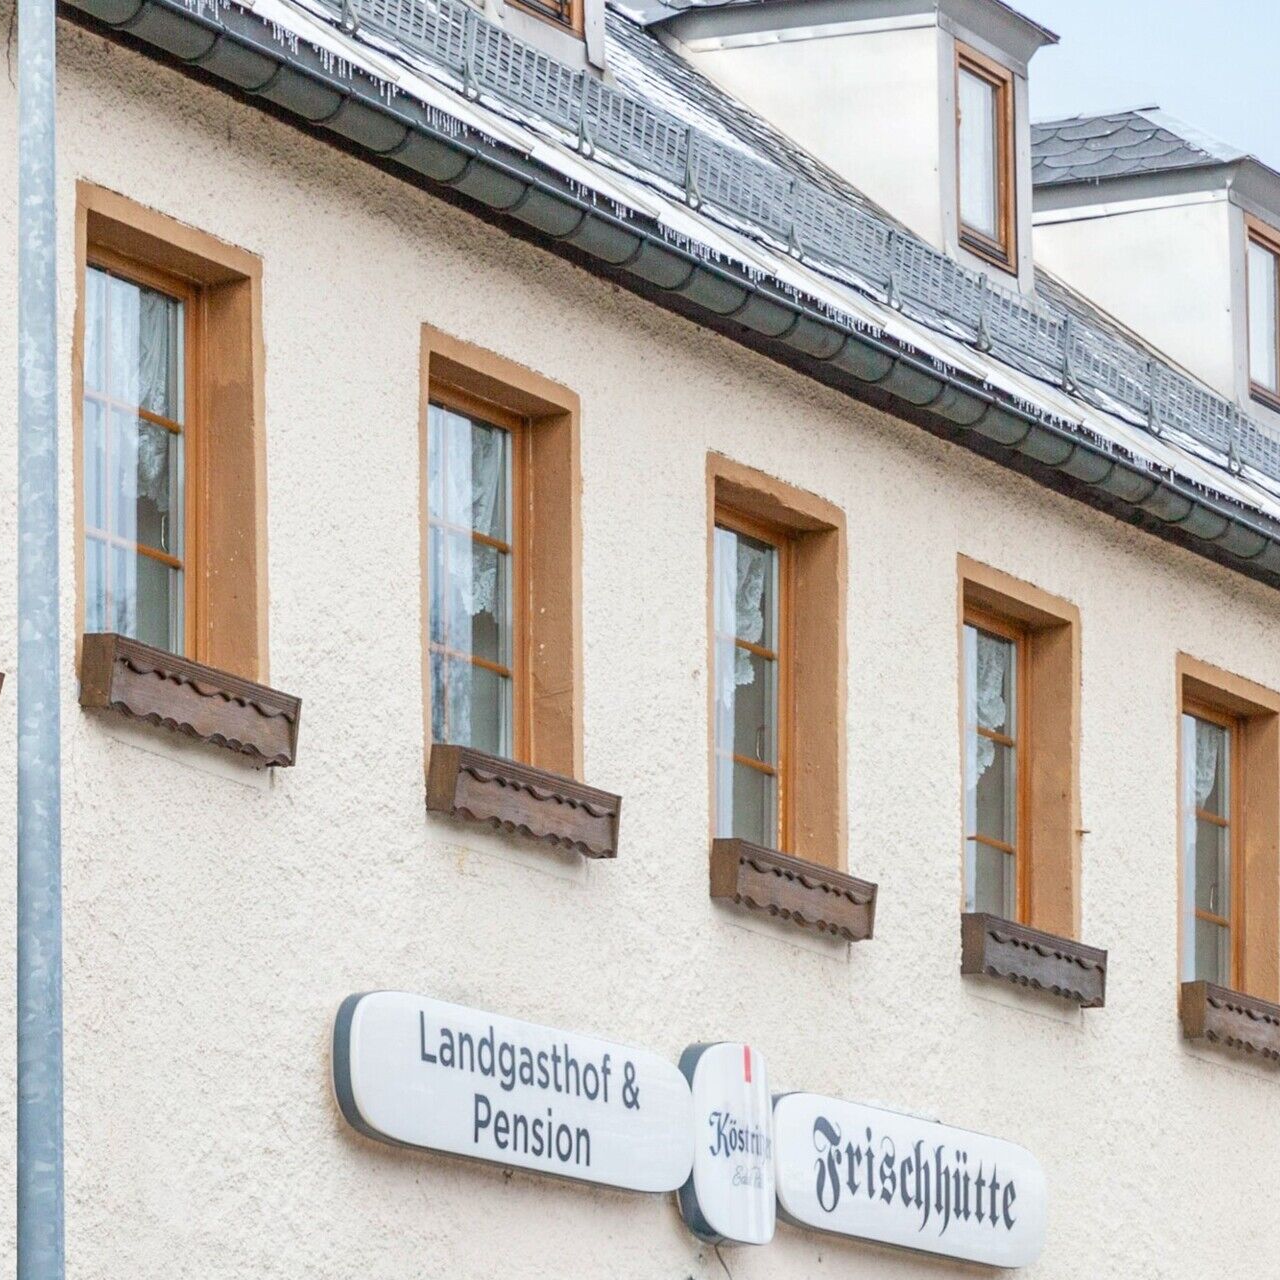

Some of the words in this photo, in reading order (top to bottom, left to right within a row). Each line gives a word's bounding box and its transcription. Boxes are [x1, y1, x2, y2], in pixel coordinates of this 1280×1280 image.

[419, 1010, 611, 1103] Landgasthof
[622, 1060, 640, 1110] &
[474, 1092, 591, 1167] Pension
[813, 1116, 1017, 1237] Frischhütte
